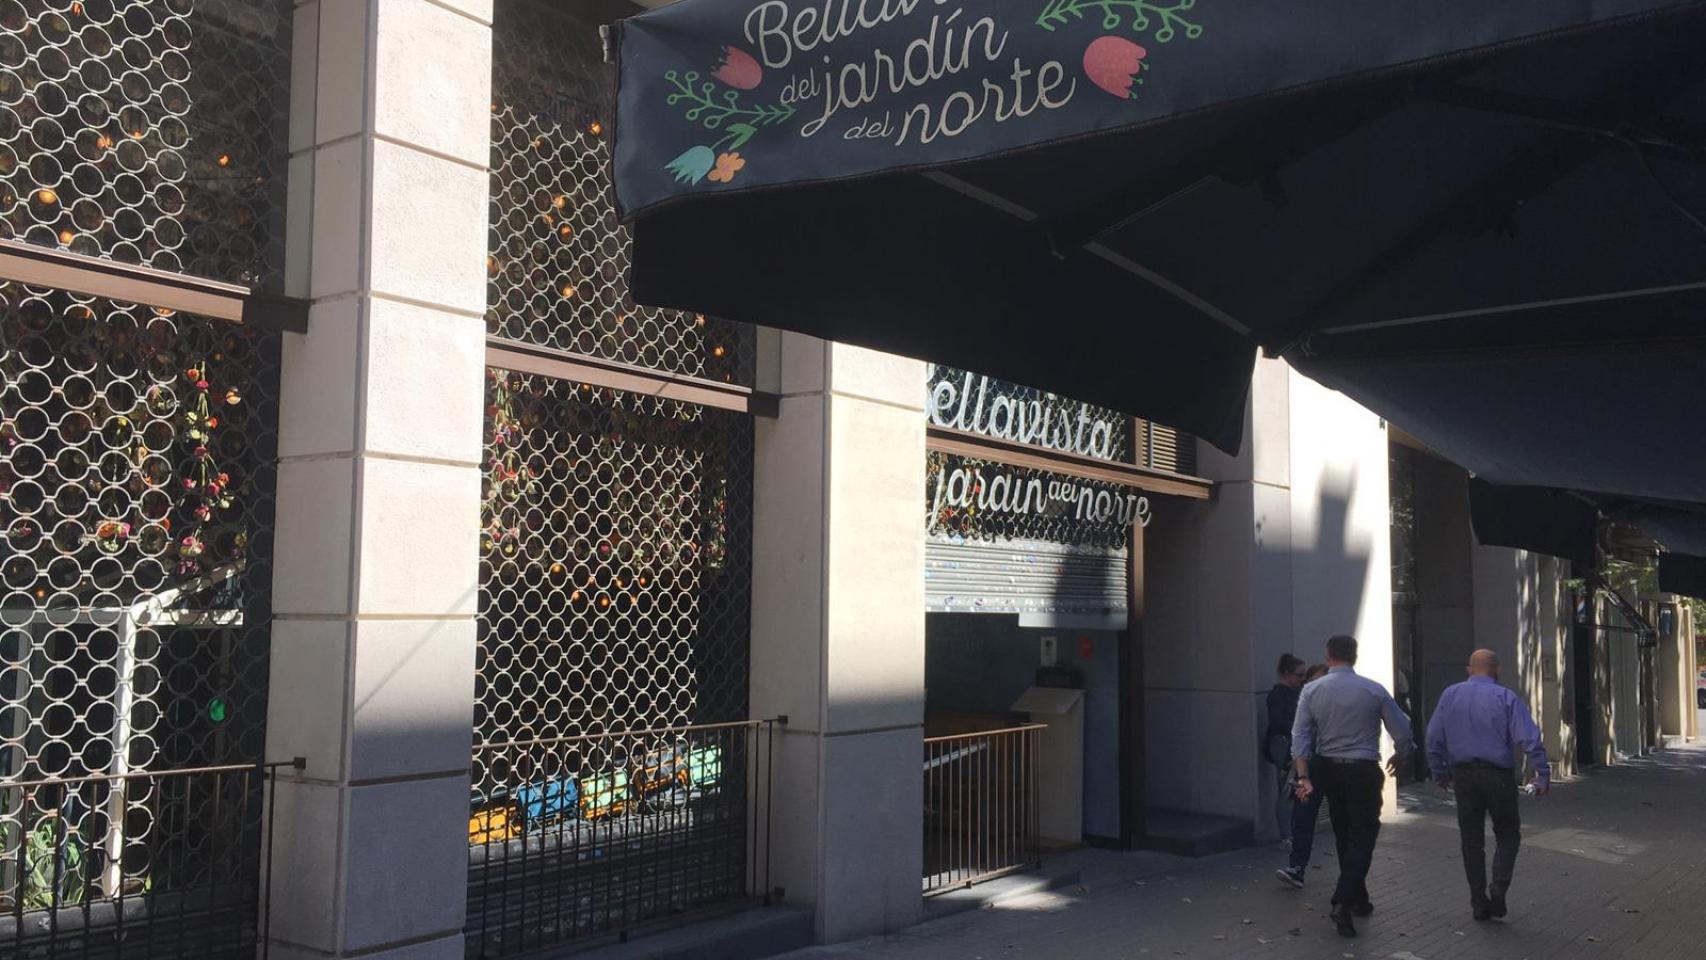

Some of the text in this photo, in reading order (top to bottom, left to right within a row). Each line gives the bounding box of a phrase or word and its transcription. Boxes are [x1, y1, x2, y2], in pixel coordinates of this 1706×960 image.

[780, 8, 1008, 137] del jardín
[843, 57, 1076, 145] del norte
[926, 362, 1117, 460] ellavista
[1076, 484, 1151, 527] norte
